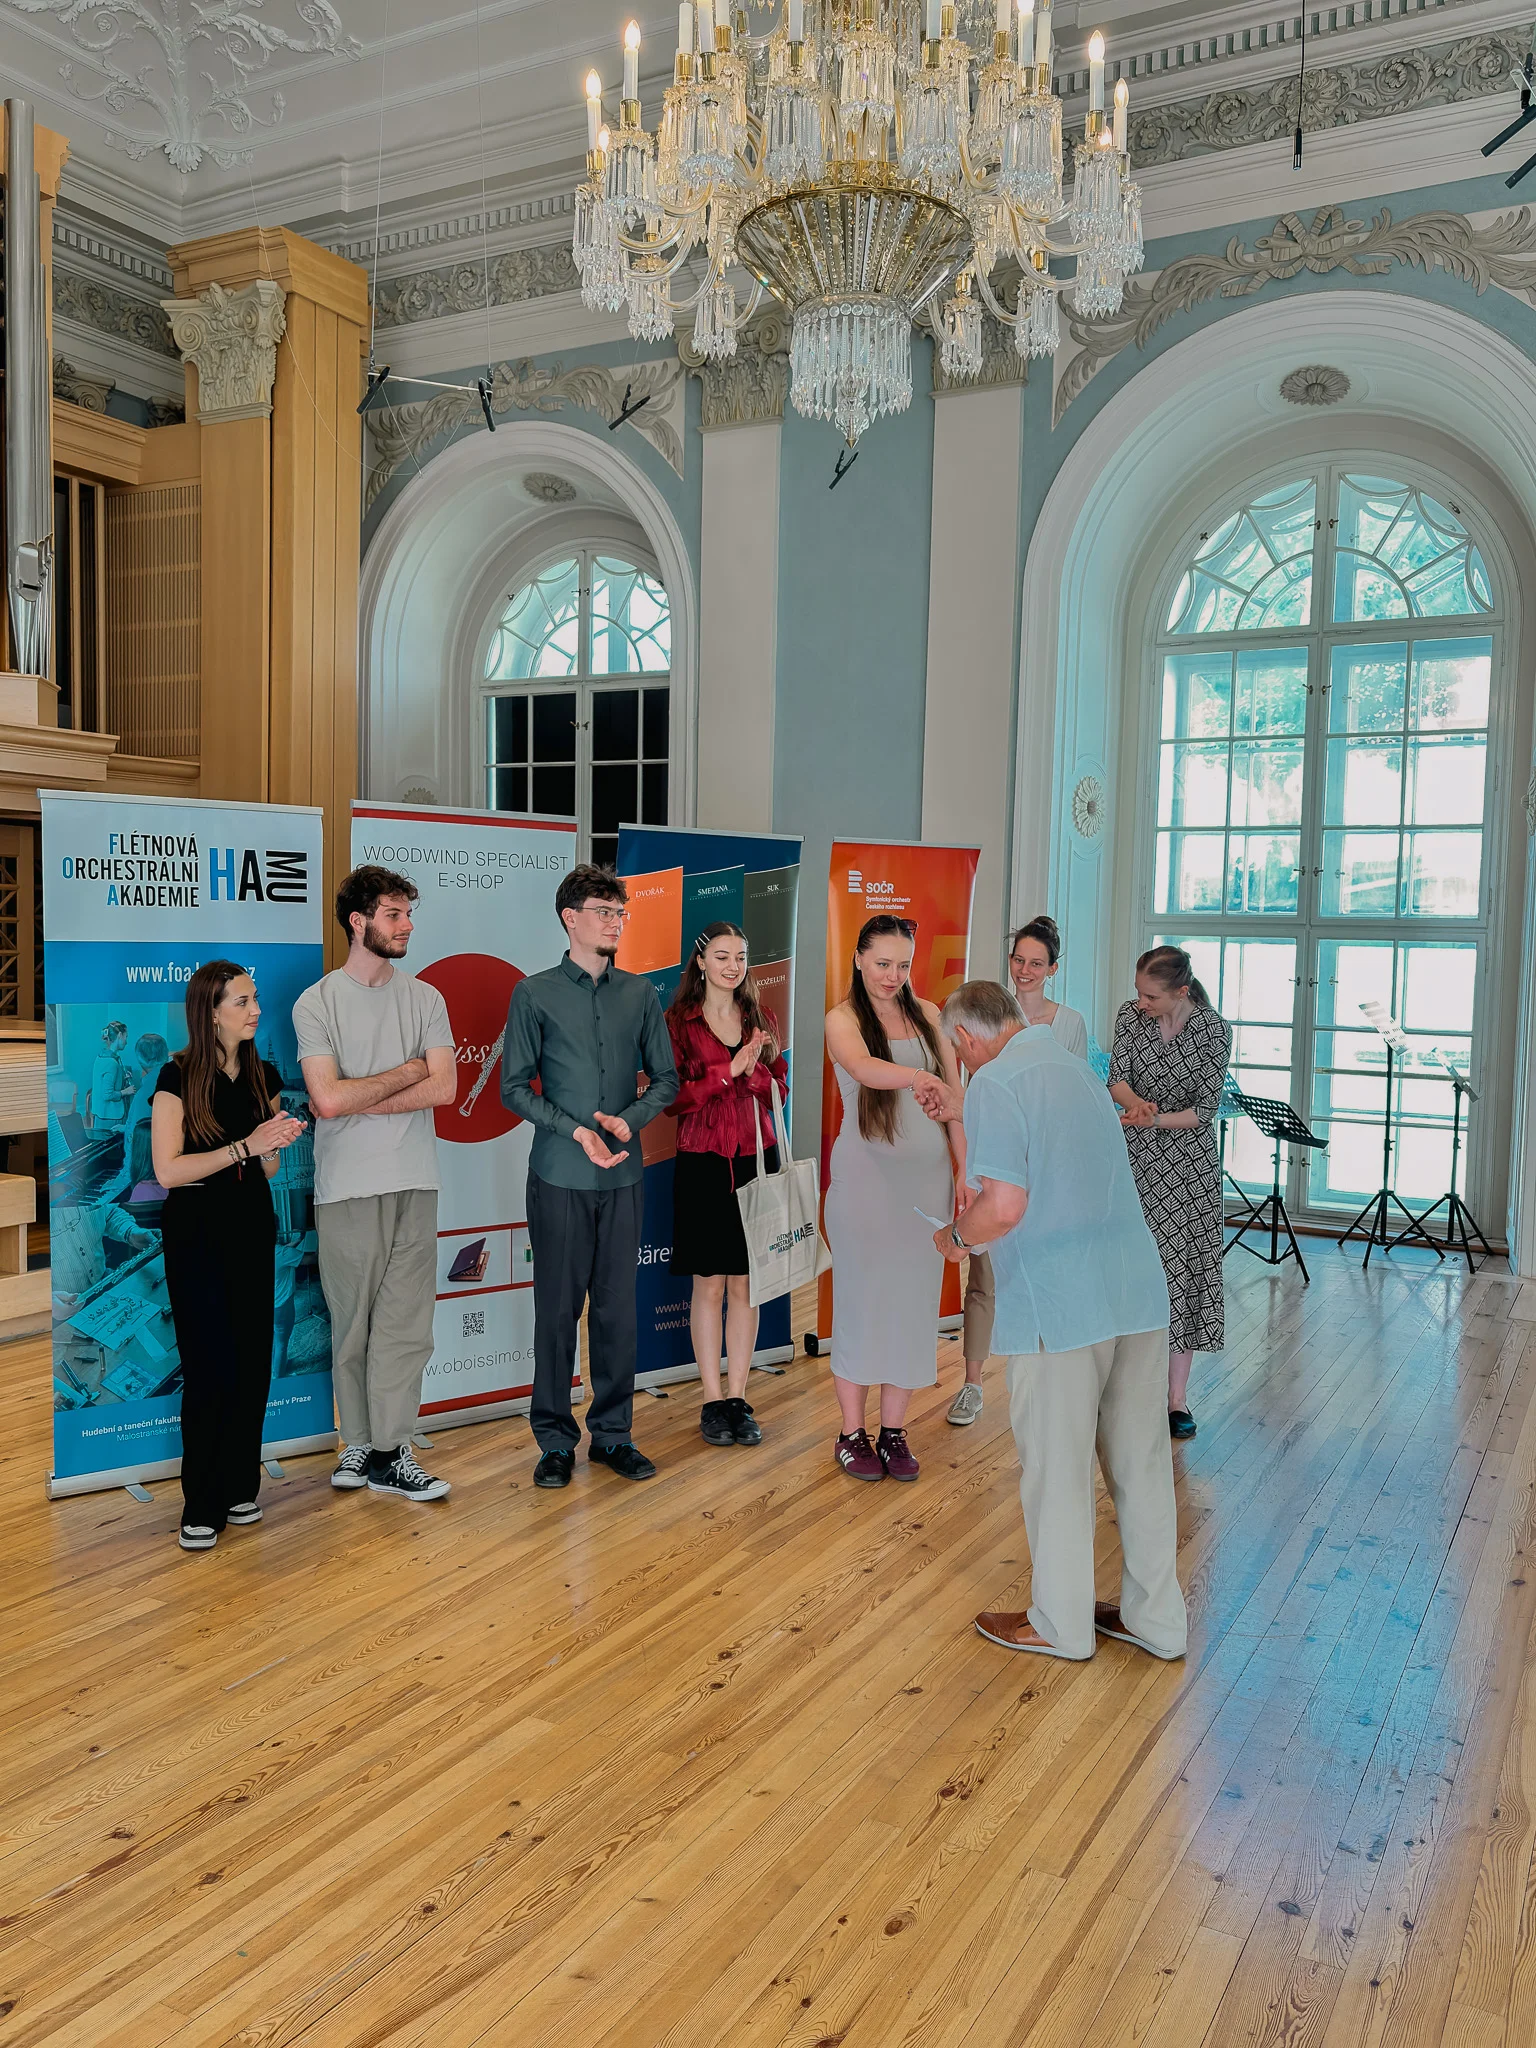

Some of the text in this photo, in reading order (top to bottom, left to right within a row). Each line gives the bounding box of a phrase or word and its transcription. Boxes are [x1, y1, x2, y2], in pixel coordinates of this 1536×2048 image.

[109, 830, 199, 858] FLÉTNOVÁ
[363, 845, 569, 871] WOODWIND SPECIALIST
[62, 856, 199, 883] ORCHESTRÁLNÍ
[438, 872, 504, 889] E-SHOP
[766, 883, 780, 893] SUK
[866, 880, 894, 894] SOČR
[107, 884, 199, 908] AKADEMIE
[635, 886, 665, 898] DVOŘÁK
[697, 884, 729, 896] SMETANA
[756, 974, 786, 987] KOŽELUH
[424, 1347, 536, 1377] w.oboissimo.e
[81, 1424, 116, 1438] Hudební
[124, 1418, 154, 1431] taneční
[154, 1415, 182, 1426] fakulta
[266, 1398, 285, 1408] mění
[291, 1395, 312, 1404] Praze
[116, 1427, 169, 1442] Malostranské
